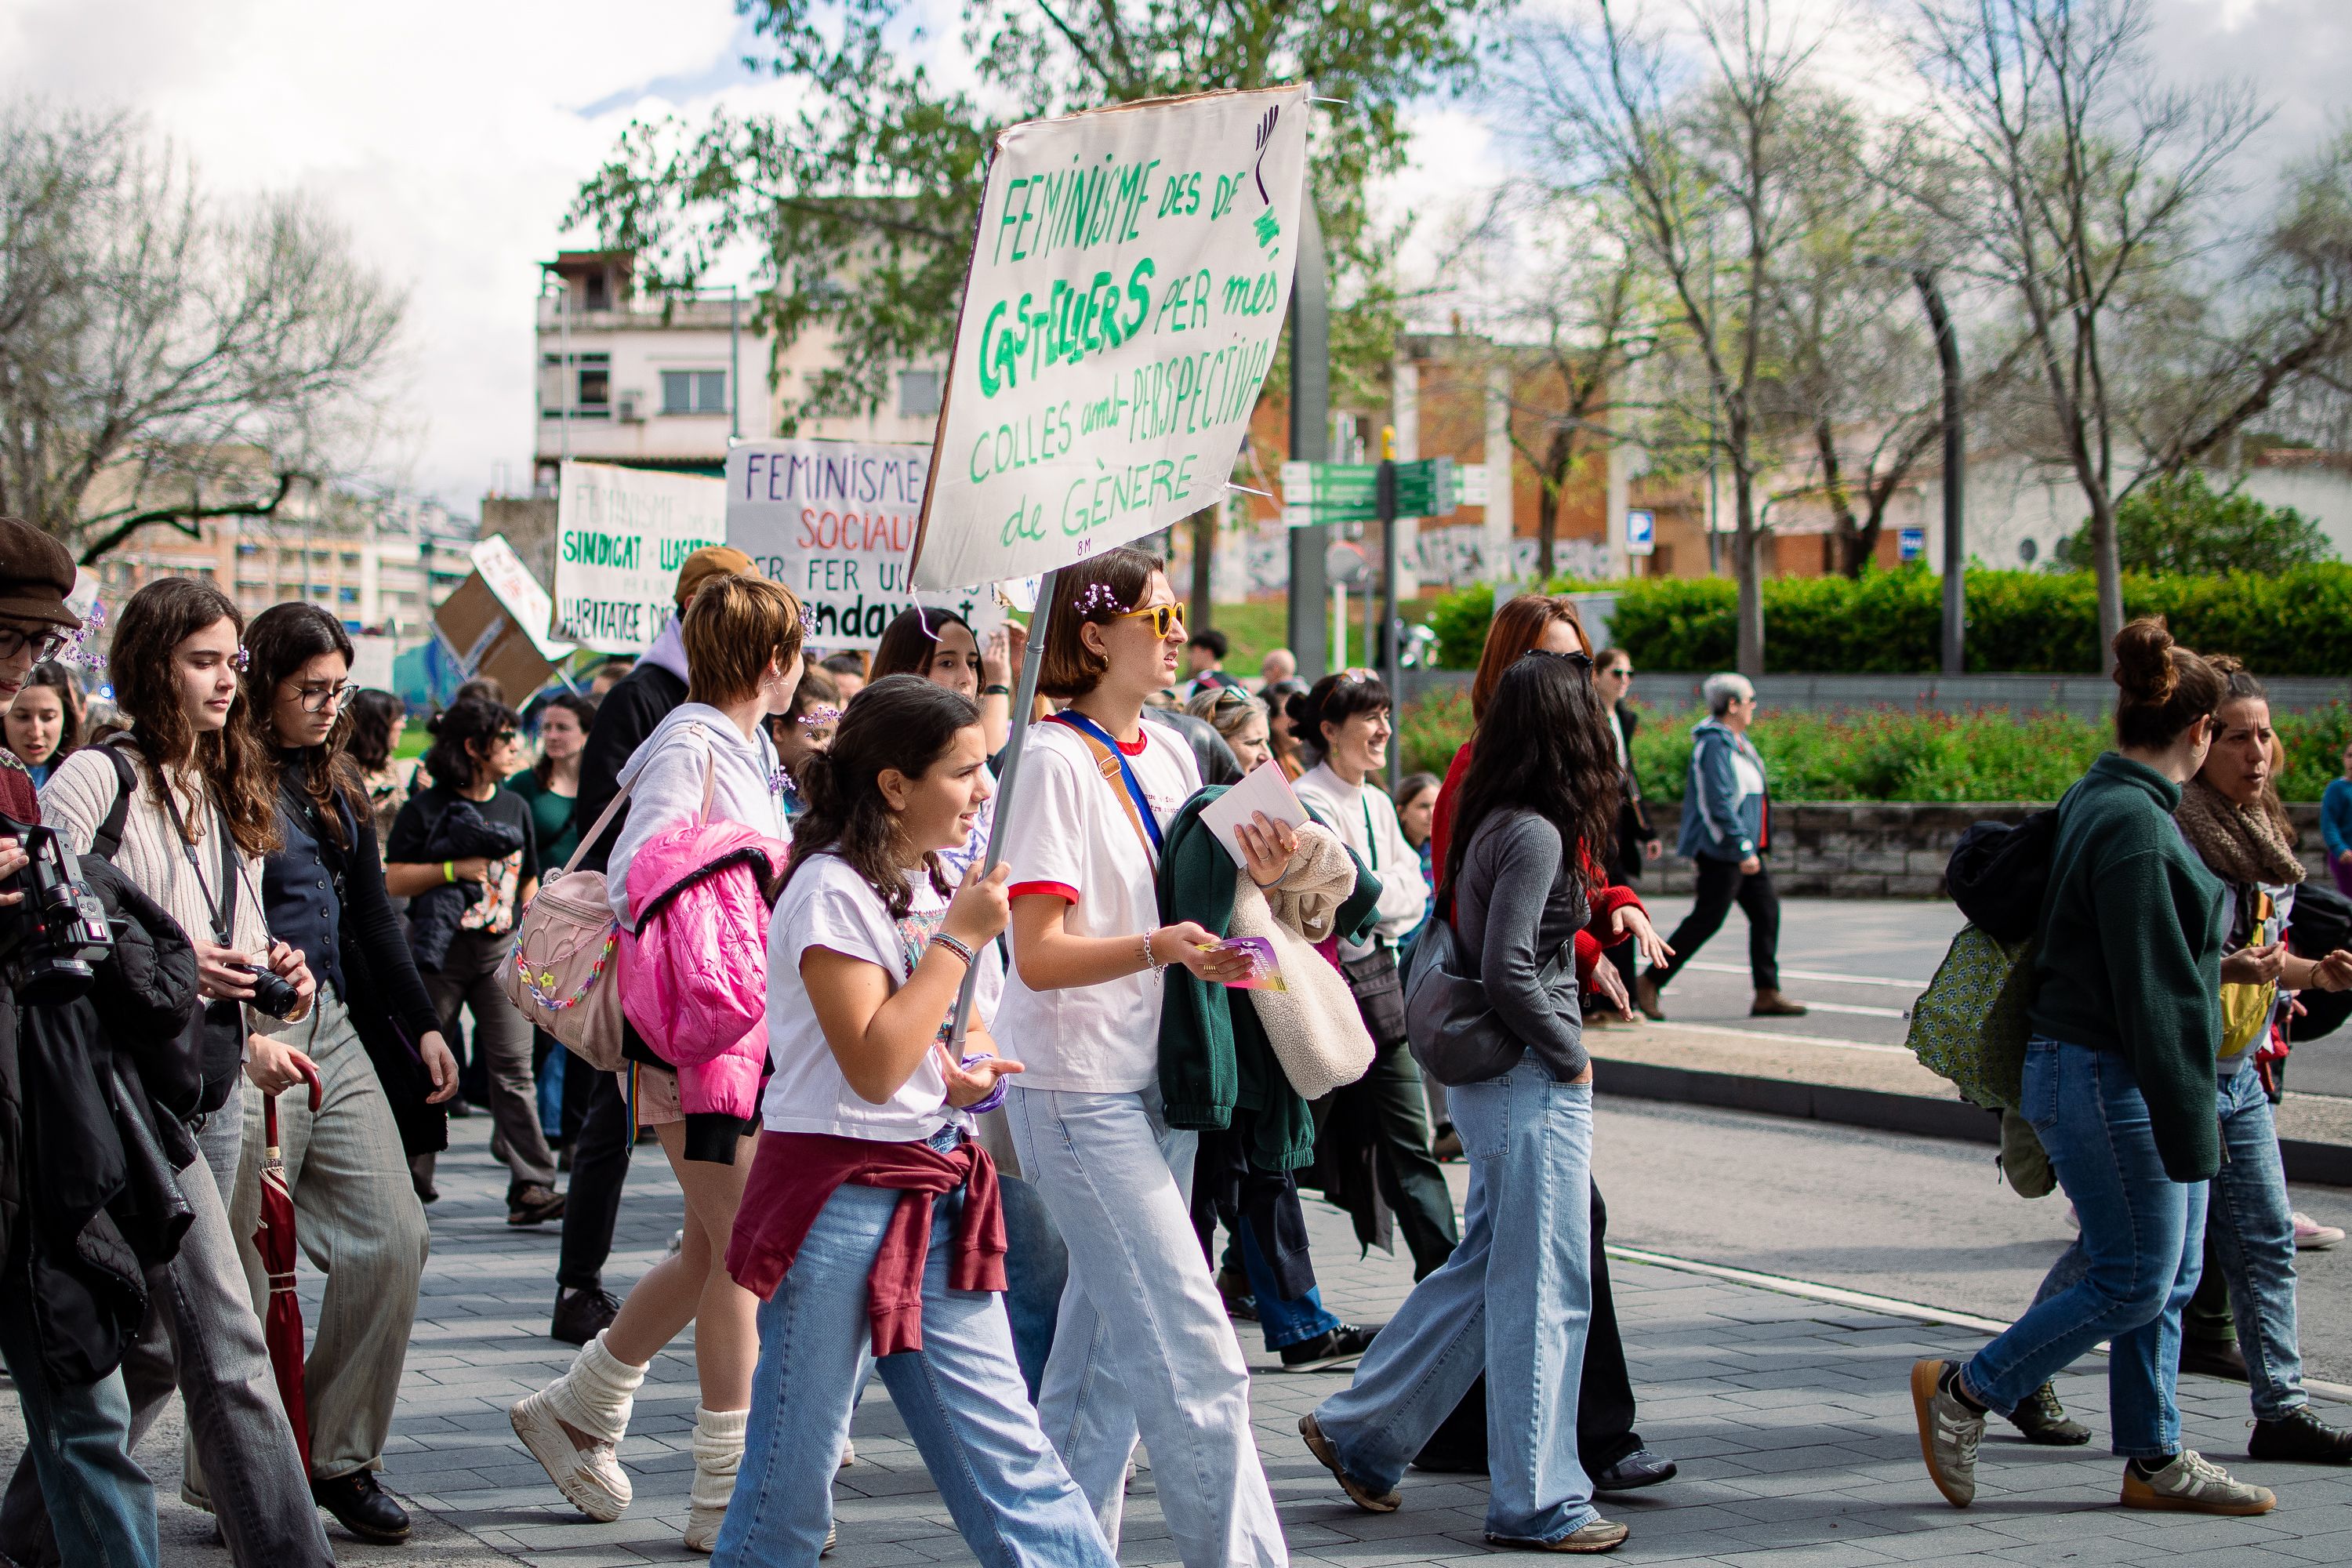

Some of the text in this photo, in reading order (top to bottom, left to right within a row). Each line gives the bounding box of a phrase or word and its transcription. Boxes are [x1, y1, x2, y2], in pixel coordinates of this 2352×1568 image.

[1157, 171, 1202, 220] DES
[1210, 171, 1247, 222] DE
[978, 257, 1156, 399] CASTELLERS
[1153, 268, 1211, 335] PER
[970, 400, 1072, 485] COLLES
[999, 454, 1198, 547] de GÈNERE
[562, 530, 642, 571] SINDICAT
[1077, 538, 1091, 556] 8M
[808, 559, 859, 590] FER
[560, 598, 642, 642] HABITATGE
